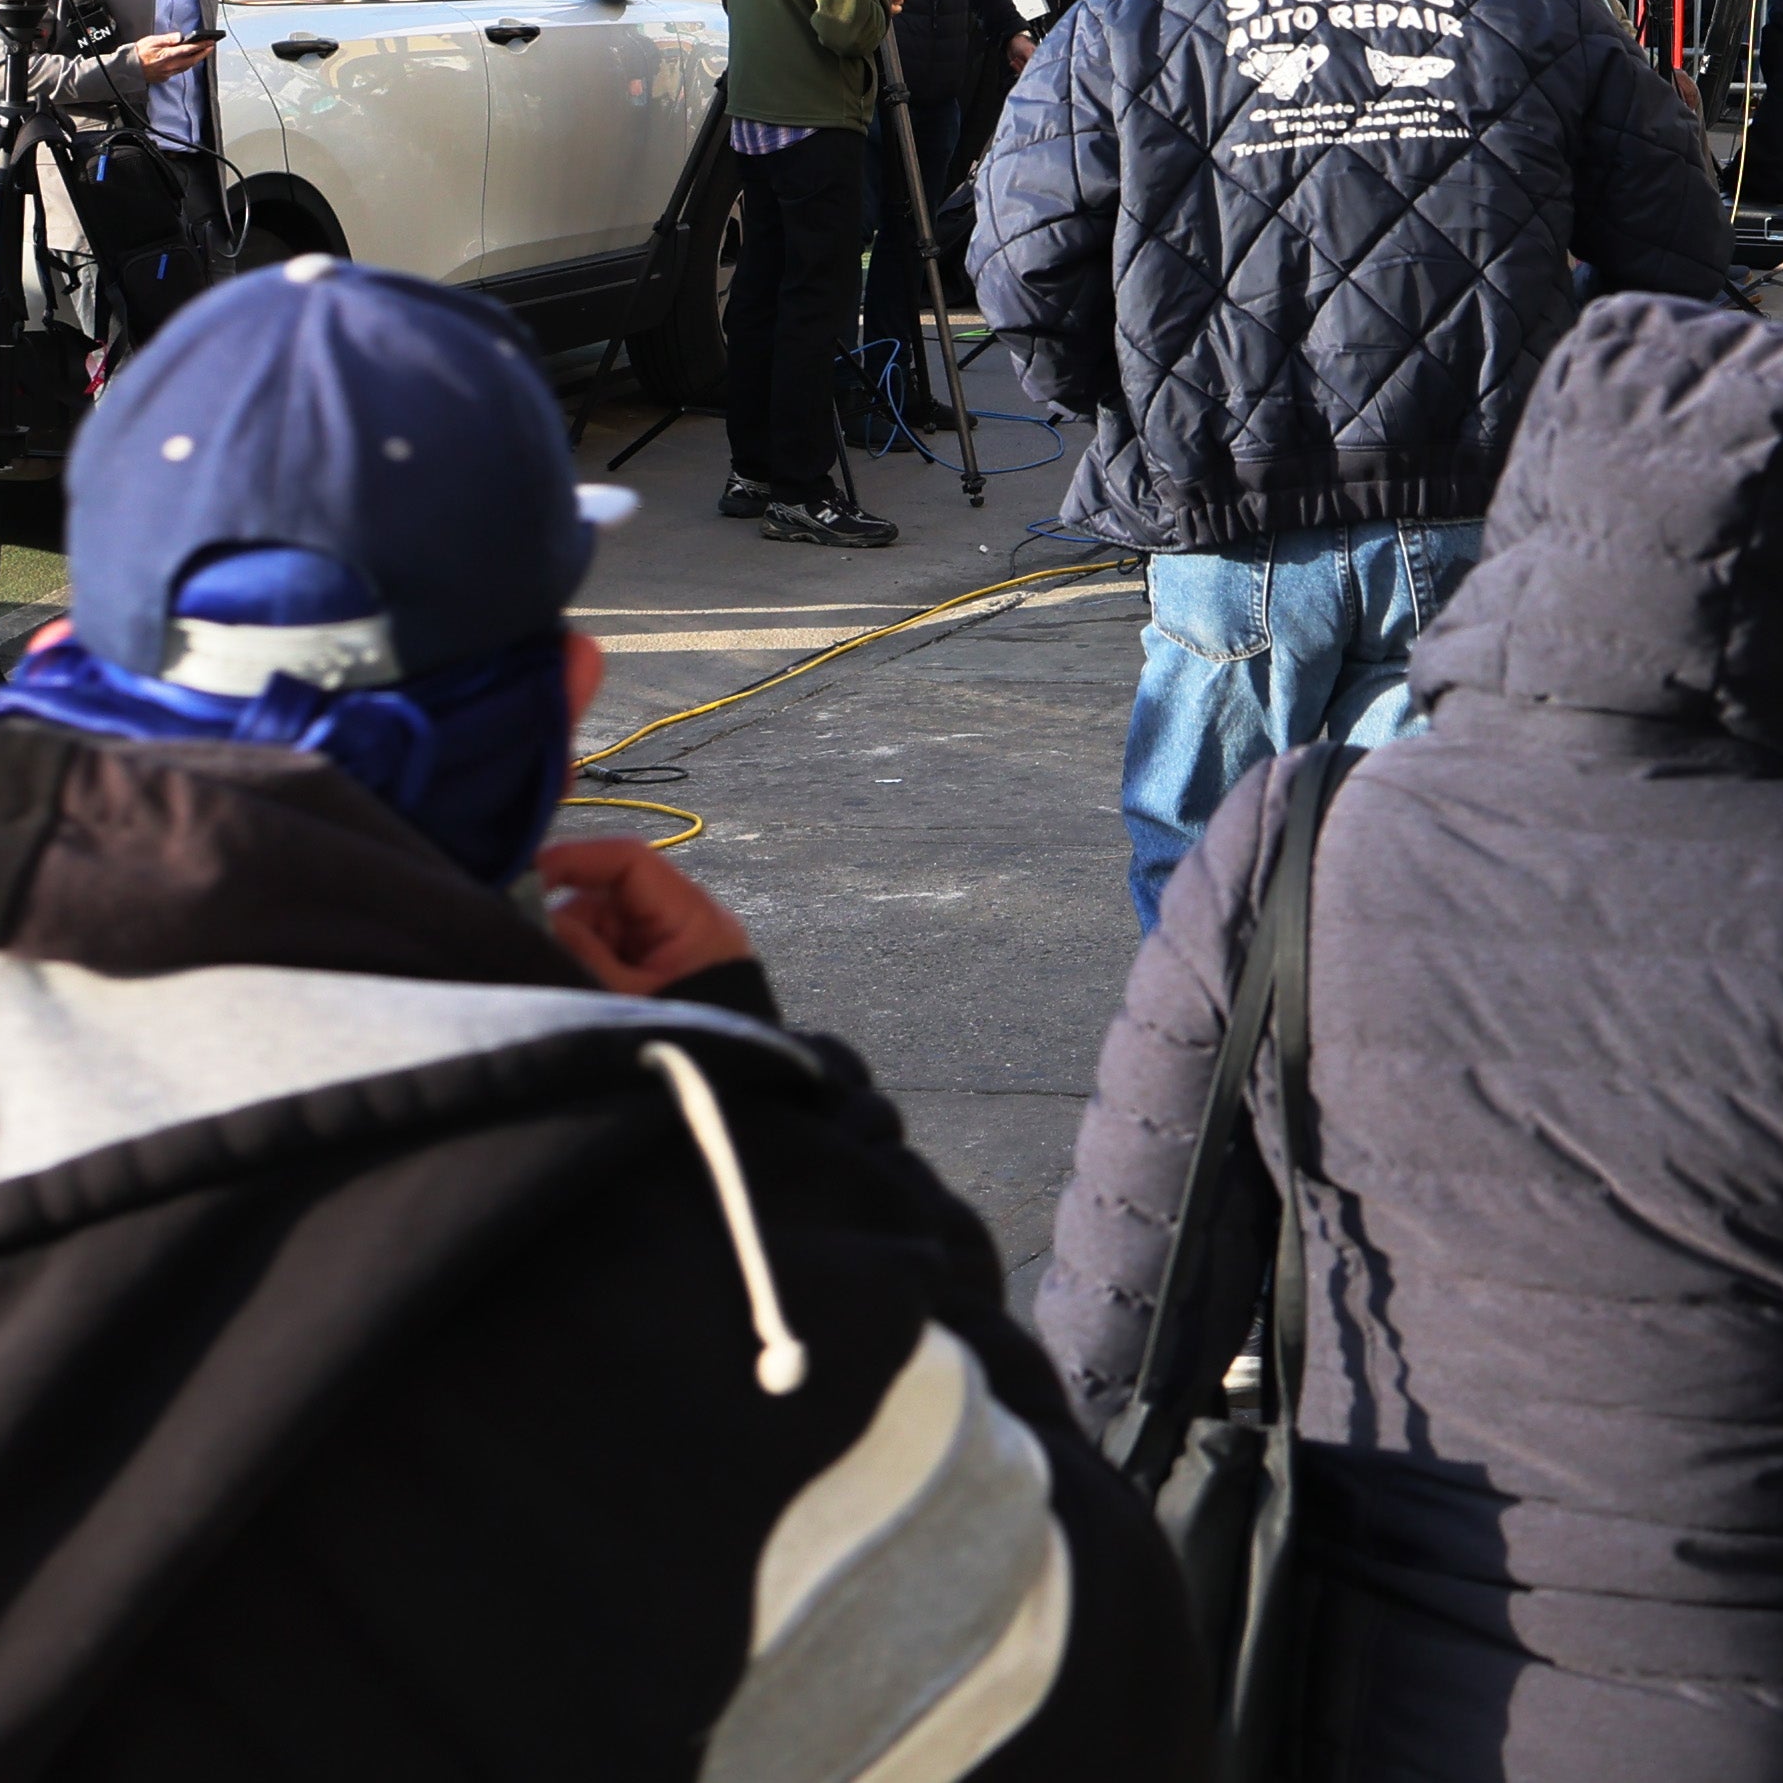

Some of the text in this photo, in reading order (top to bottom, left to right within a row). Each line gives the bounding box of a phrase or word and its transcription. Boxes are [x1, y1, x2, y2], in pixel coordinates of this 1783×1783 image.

[1225, 3, 1464, 57] AUTO REPAIR
[1249, 101, 1355, 122] Complete
[1273, 111, 1440, 134] Engine Rebuilt
